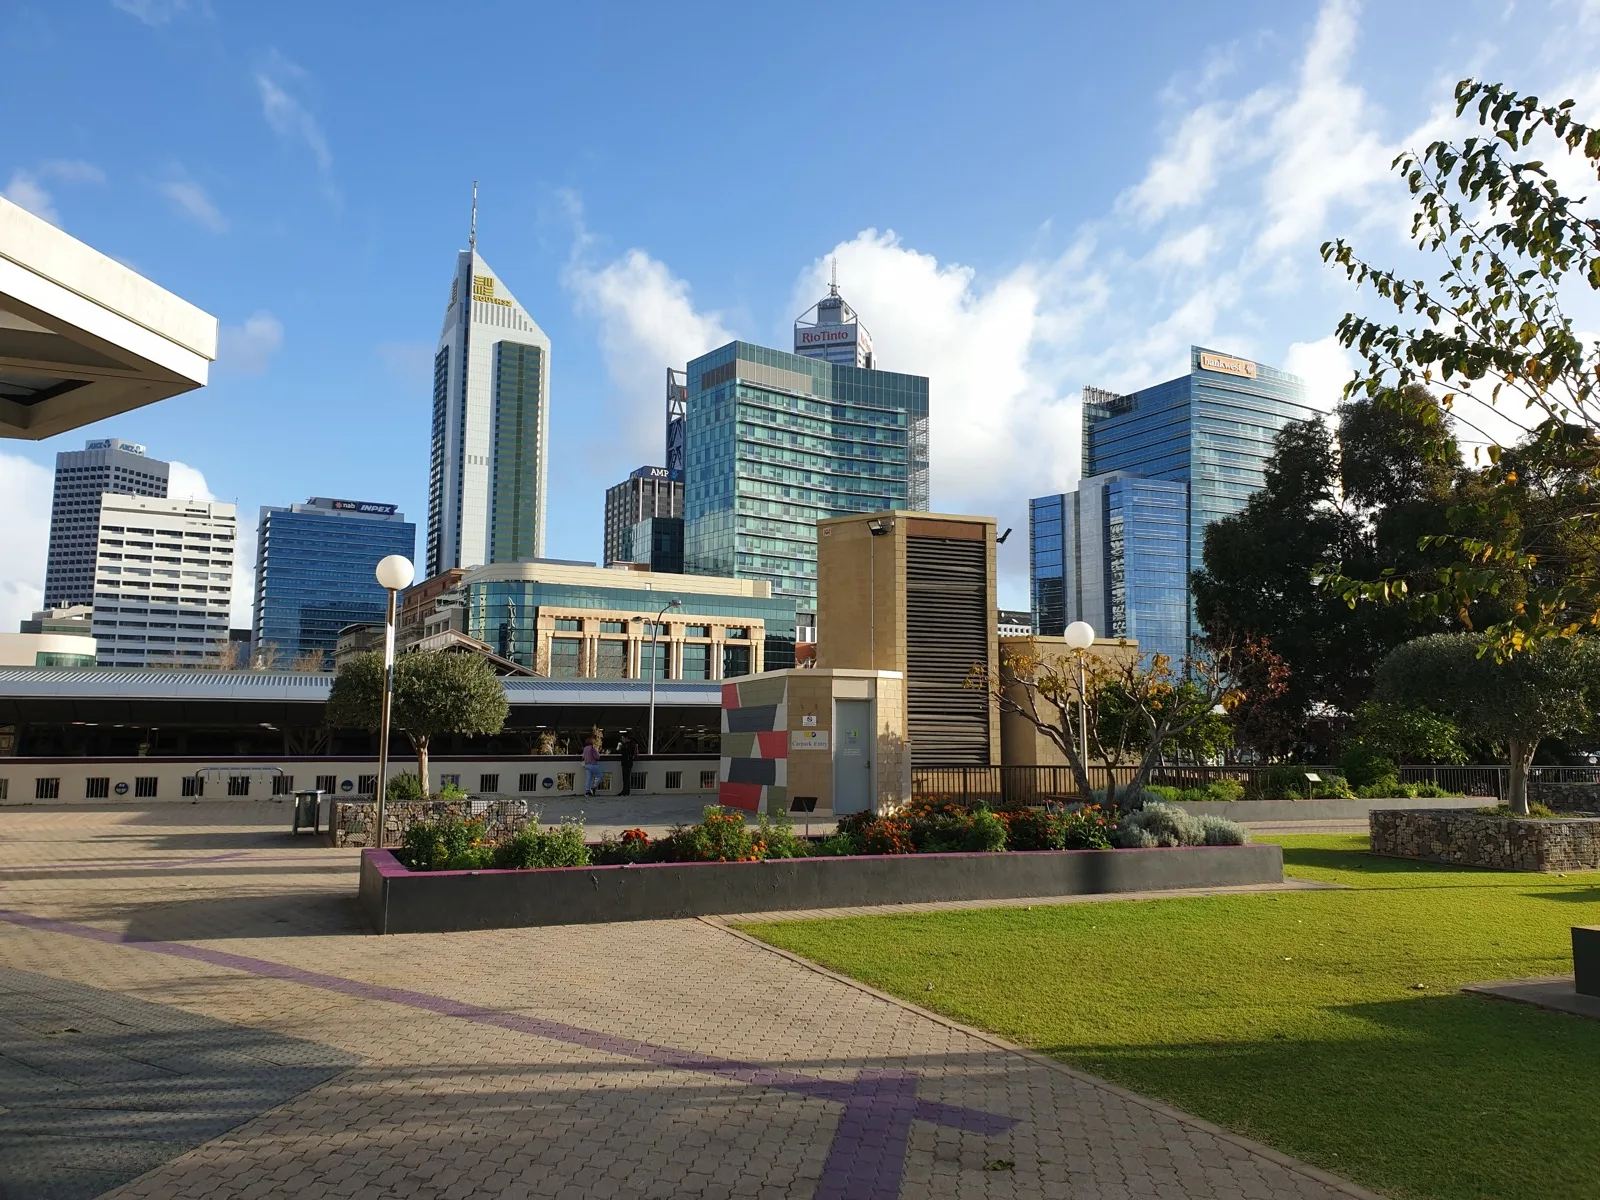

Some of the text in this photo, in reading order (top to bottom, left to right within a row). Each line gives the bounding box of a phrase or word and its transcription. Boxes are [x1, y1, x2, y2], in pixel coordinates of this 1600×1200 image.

[473, 295, 513, 307] SOUTH32
[1202, 356, 1241, 372] bankwest
[88, 442, 104, 450] ANZ
[650, 468, 670, 477] AMP
[360, 504, 391, 513] INPEX
[792, 740, 827, 748] Carpark Entry
